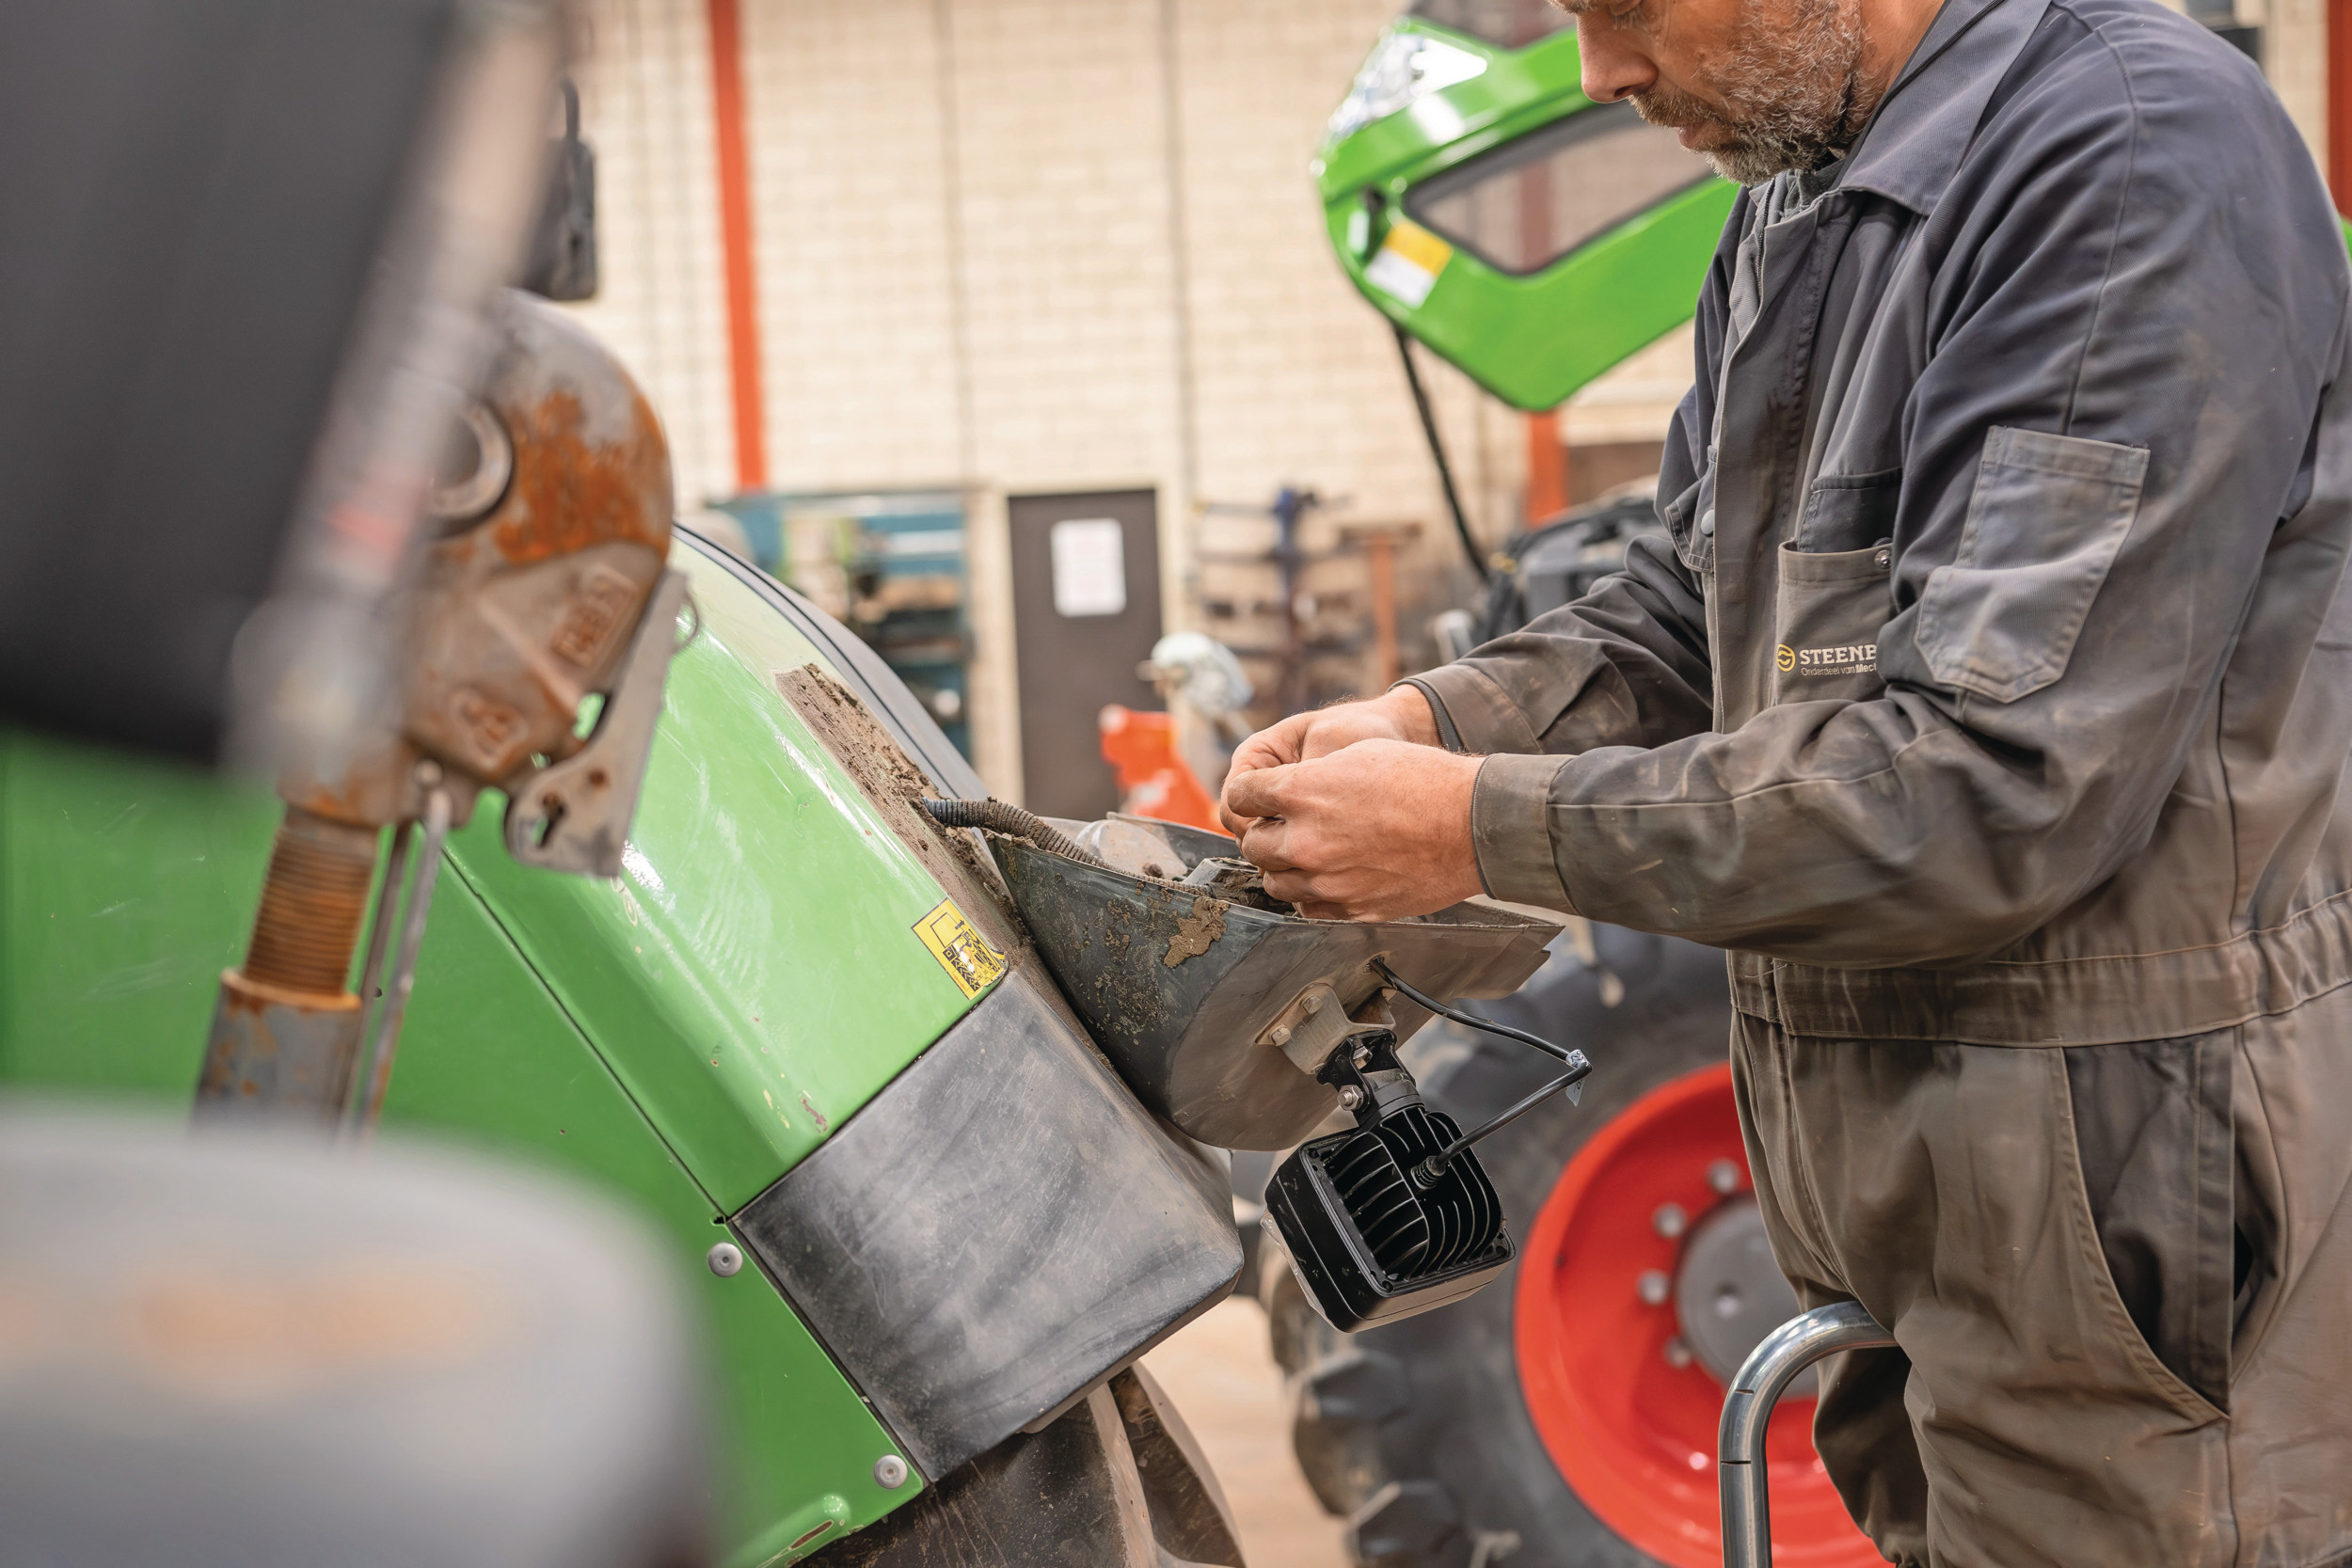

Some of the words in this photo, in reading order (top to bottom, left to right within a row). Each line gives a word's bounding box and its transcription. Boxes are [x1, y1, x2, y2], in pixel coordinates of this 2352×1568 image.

[1799, 643, 1877, 665] STEENB
[1801, 666, 1839, 676] Onderdeel
[1840, 666, 1855, 674] van
